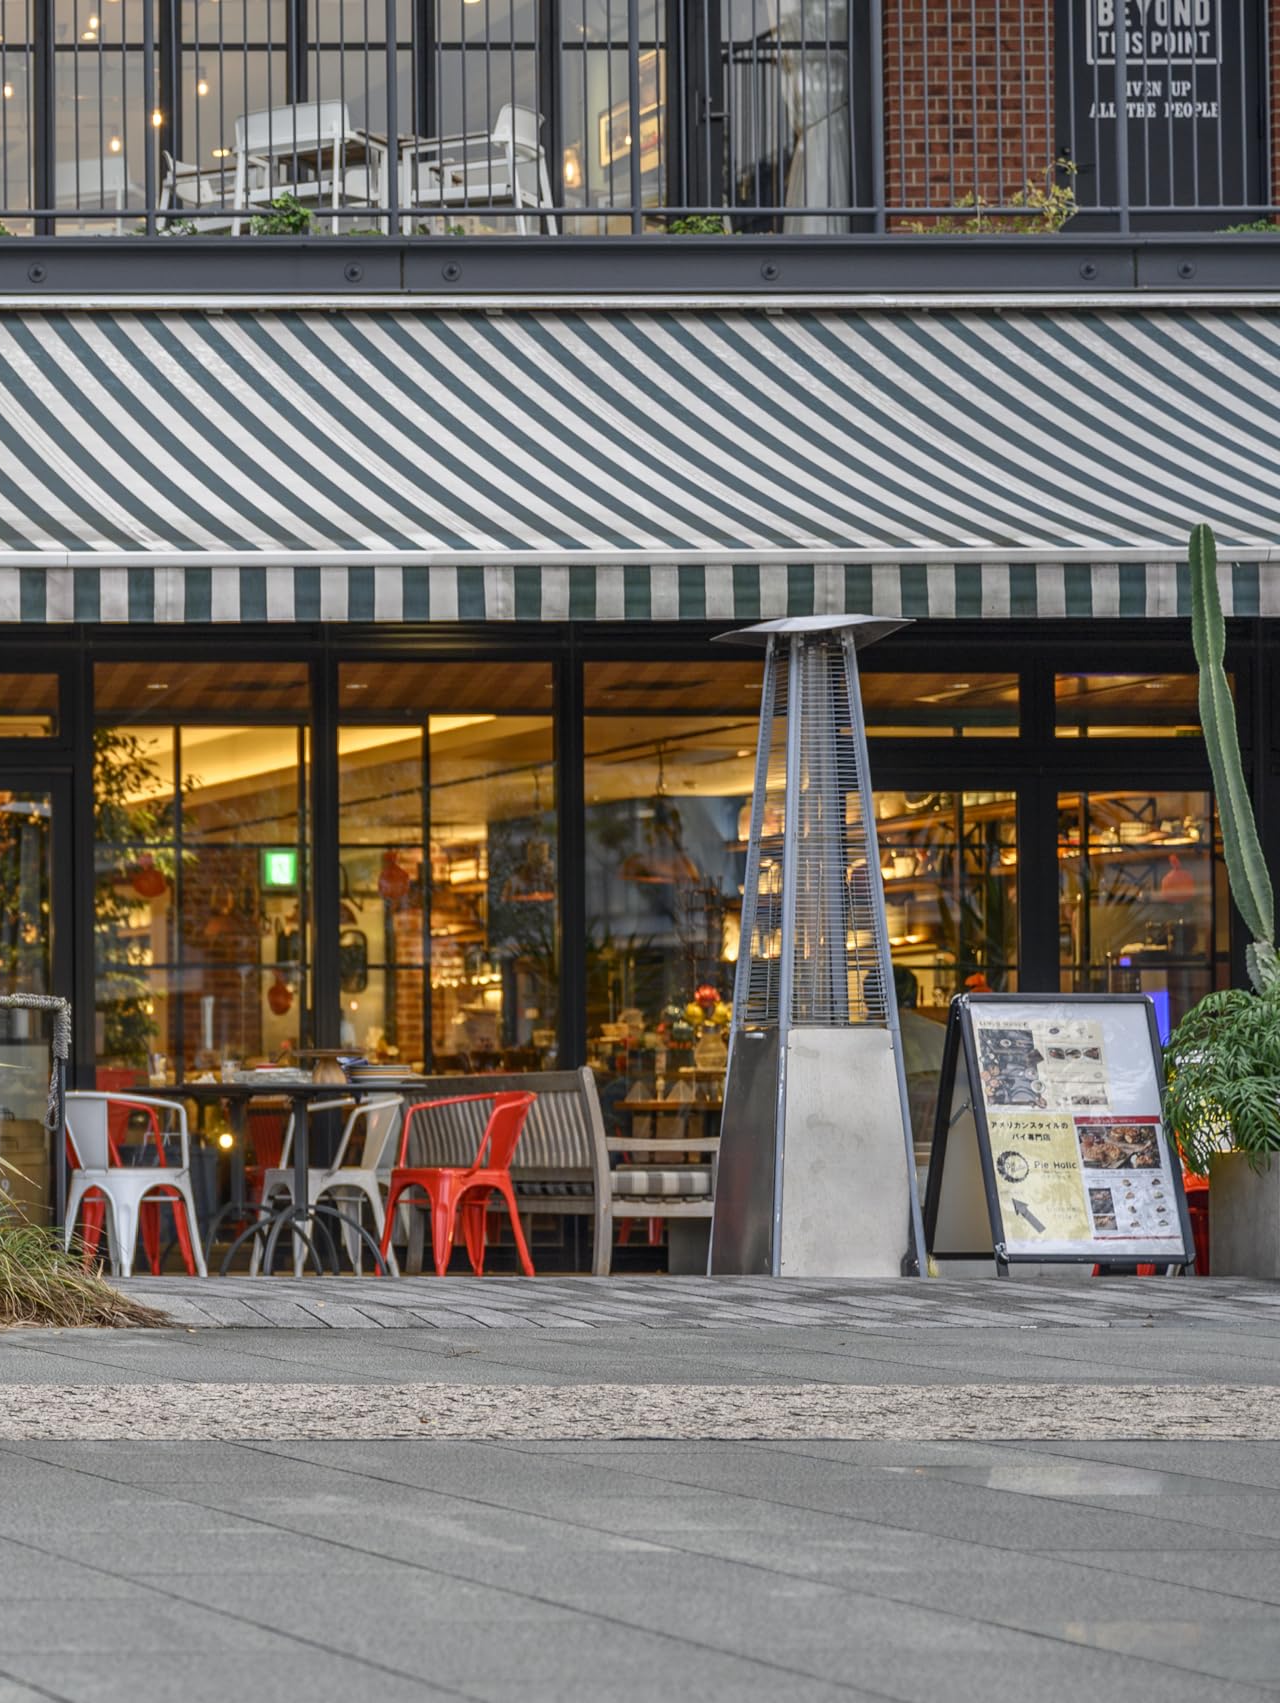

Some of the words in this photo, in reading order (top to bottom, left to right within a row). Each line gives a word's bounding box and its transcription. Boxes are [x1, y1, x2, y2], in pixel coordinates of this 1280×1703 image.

[1151, 31, 1210, 54] POINT
[1125, 80, 1162, 97] IVEN
[1170, 80, 1192, 97] UP
[1089, 102, 1117, 118] ALL
[1126, 102, 1156, 118] THE
[1164, 102, 1219, 118] PEOPLE
[1034, 1160, 1049, 1169] Pie
[1053, 1160, 1077, 1169] Holic
